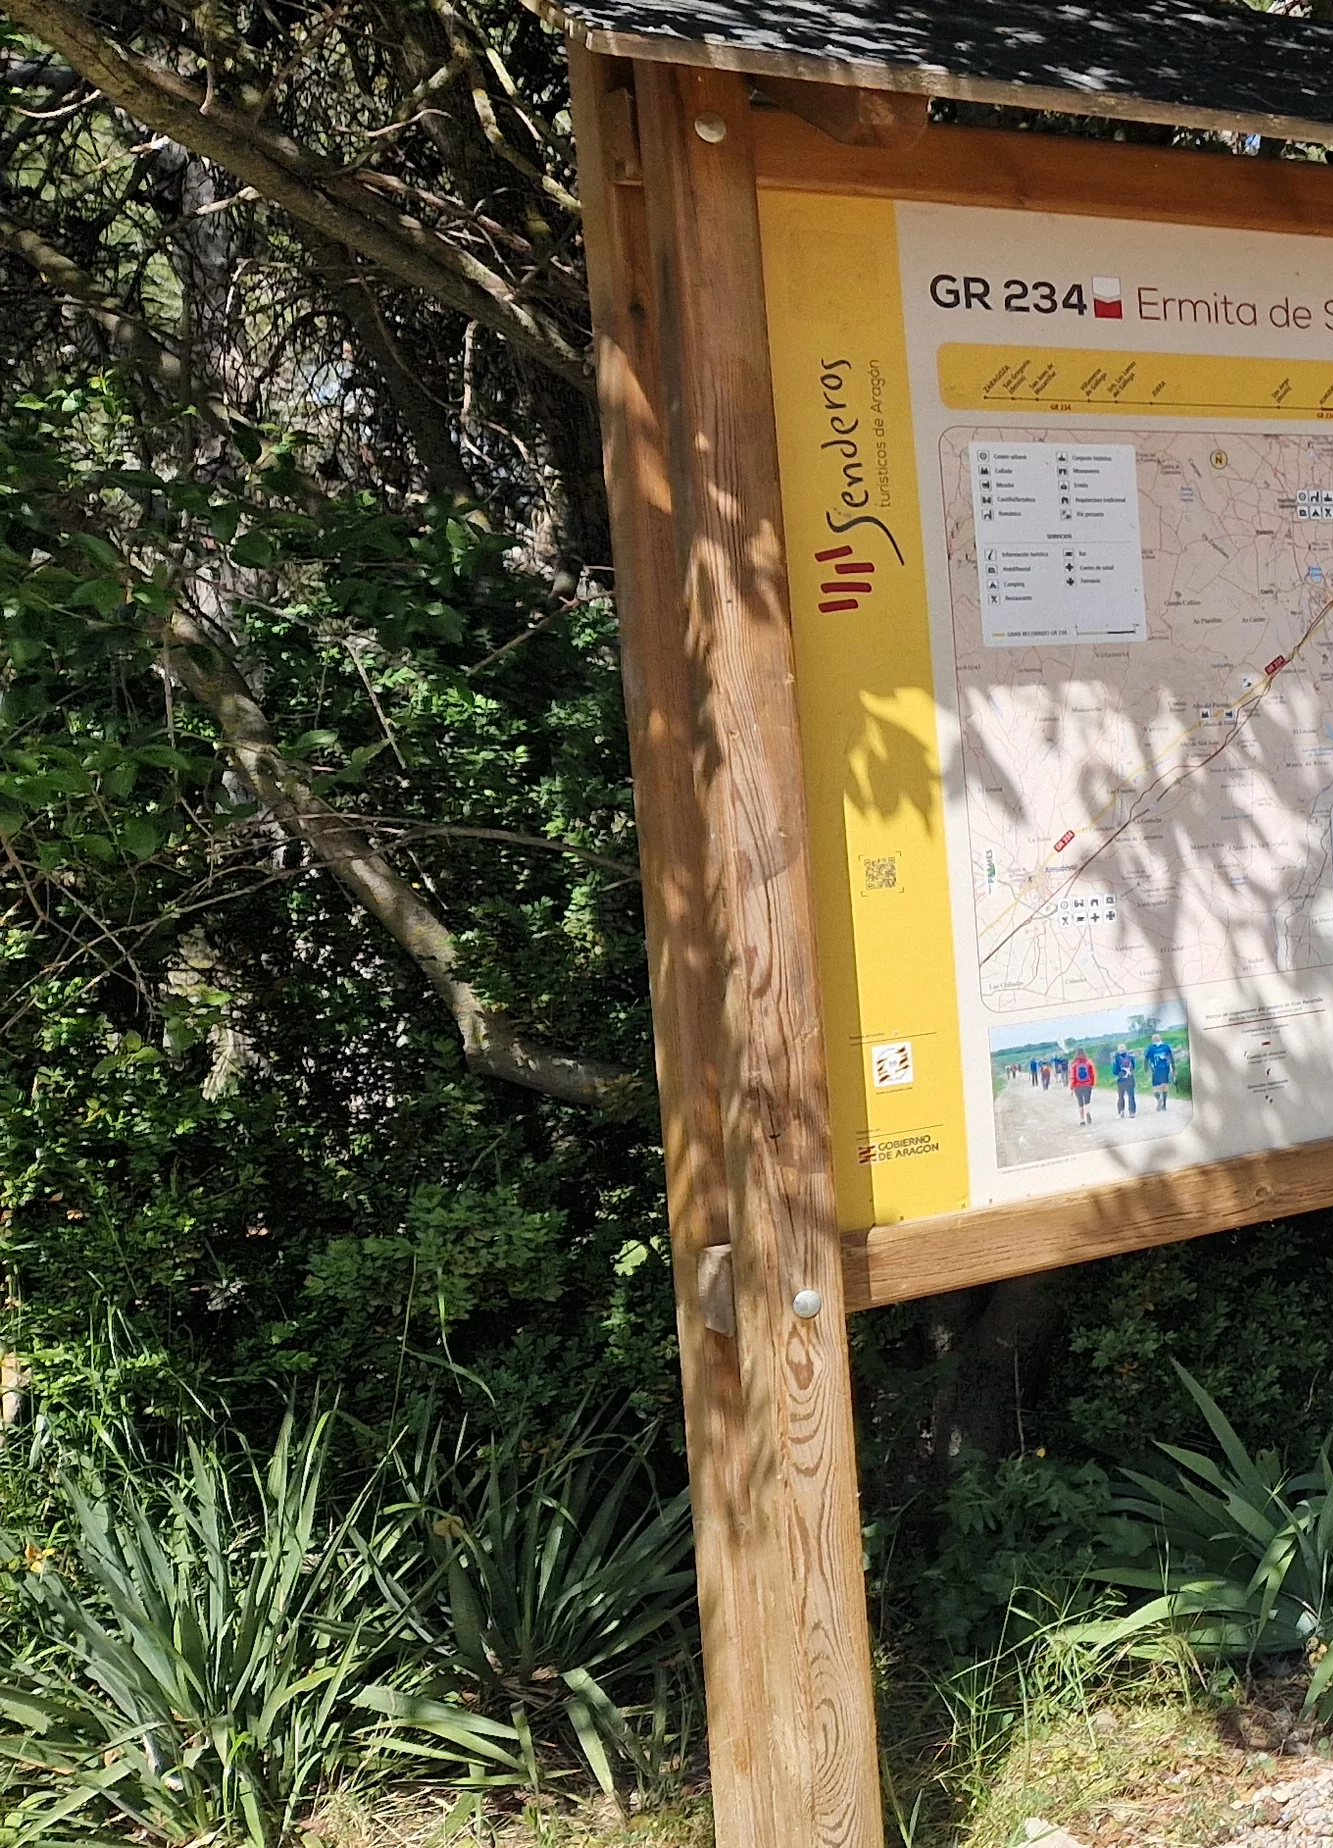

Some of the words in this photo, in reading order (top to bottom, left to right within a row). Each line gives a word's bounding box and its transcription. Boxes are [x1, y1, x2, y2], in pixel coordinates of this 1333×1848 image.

[929, 274, 994, 311] GR
[1003, 279, 1088, 316] 234
[1137, 286, 1258, 326] Ermita
[1269, 296, 1312, 329] de
[867, 359, 886, 414] Aragón
[874, 418, 885, 437] de
[820, 357, 904, 566] Senderos
[878, 1134, 931, 1152] GOBIERNO
[878, 1152, 892, 1161] DE
[895, 1142, 939, 1159] ARAGON
